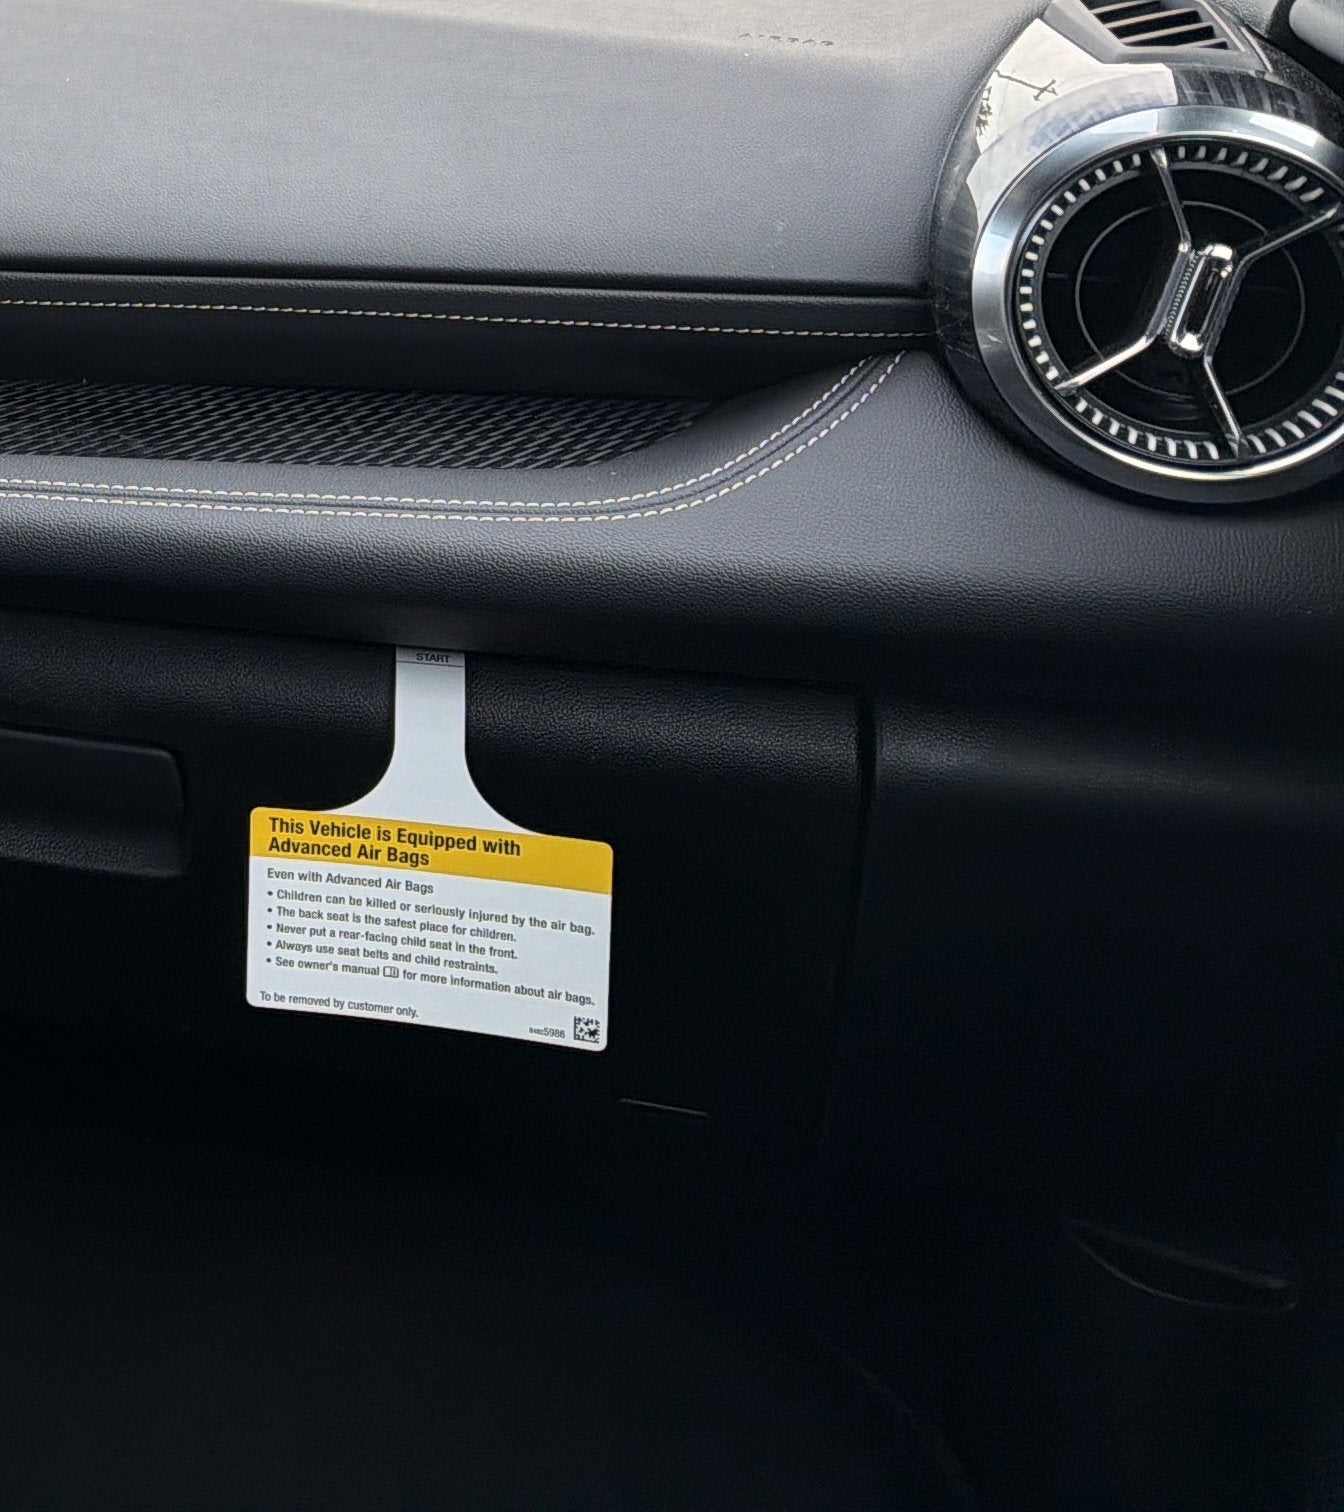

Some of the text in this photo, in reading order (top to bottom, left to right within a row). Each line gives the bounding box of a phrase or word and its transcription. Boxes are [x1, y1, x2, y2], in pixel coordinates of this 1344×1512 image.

[416, 652, 450, 663] START
[269, 816, 521, 856] This Vehicle is Equipped with
[269, 836, 430, 868] Advanced Air Bags
[268, 867, 434, 896] Even with Advanced Air Bags
[277, 888, 595, 937] Children can be killed or seriously injured by the air bag.
[277, 905, 517, 942] The back seat is the safest place for children.
[276, 922, 518, 960] Never put a rear-facing child seat in the front.
[276, 939, 498, 974] Always use seat belts and child restraints.
[276, 955, 595, 1007] See owner's manual for more information about air bags.
[260, 990, 419, 1019] To be removed by customer only.
